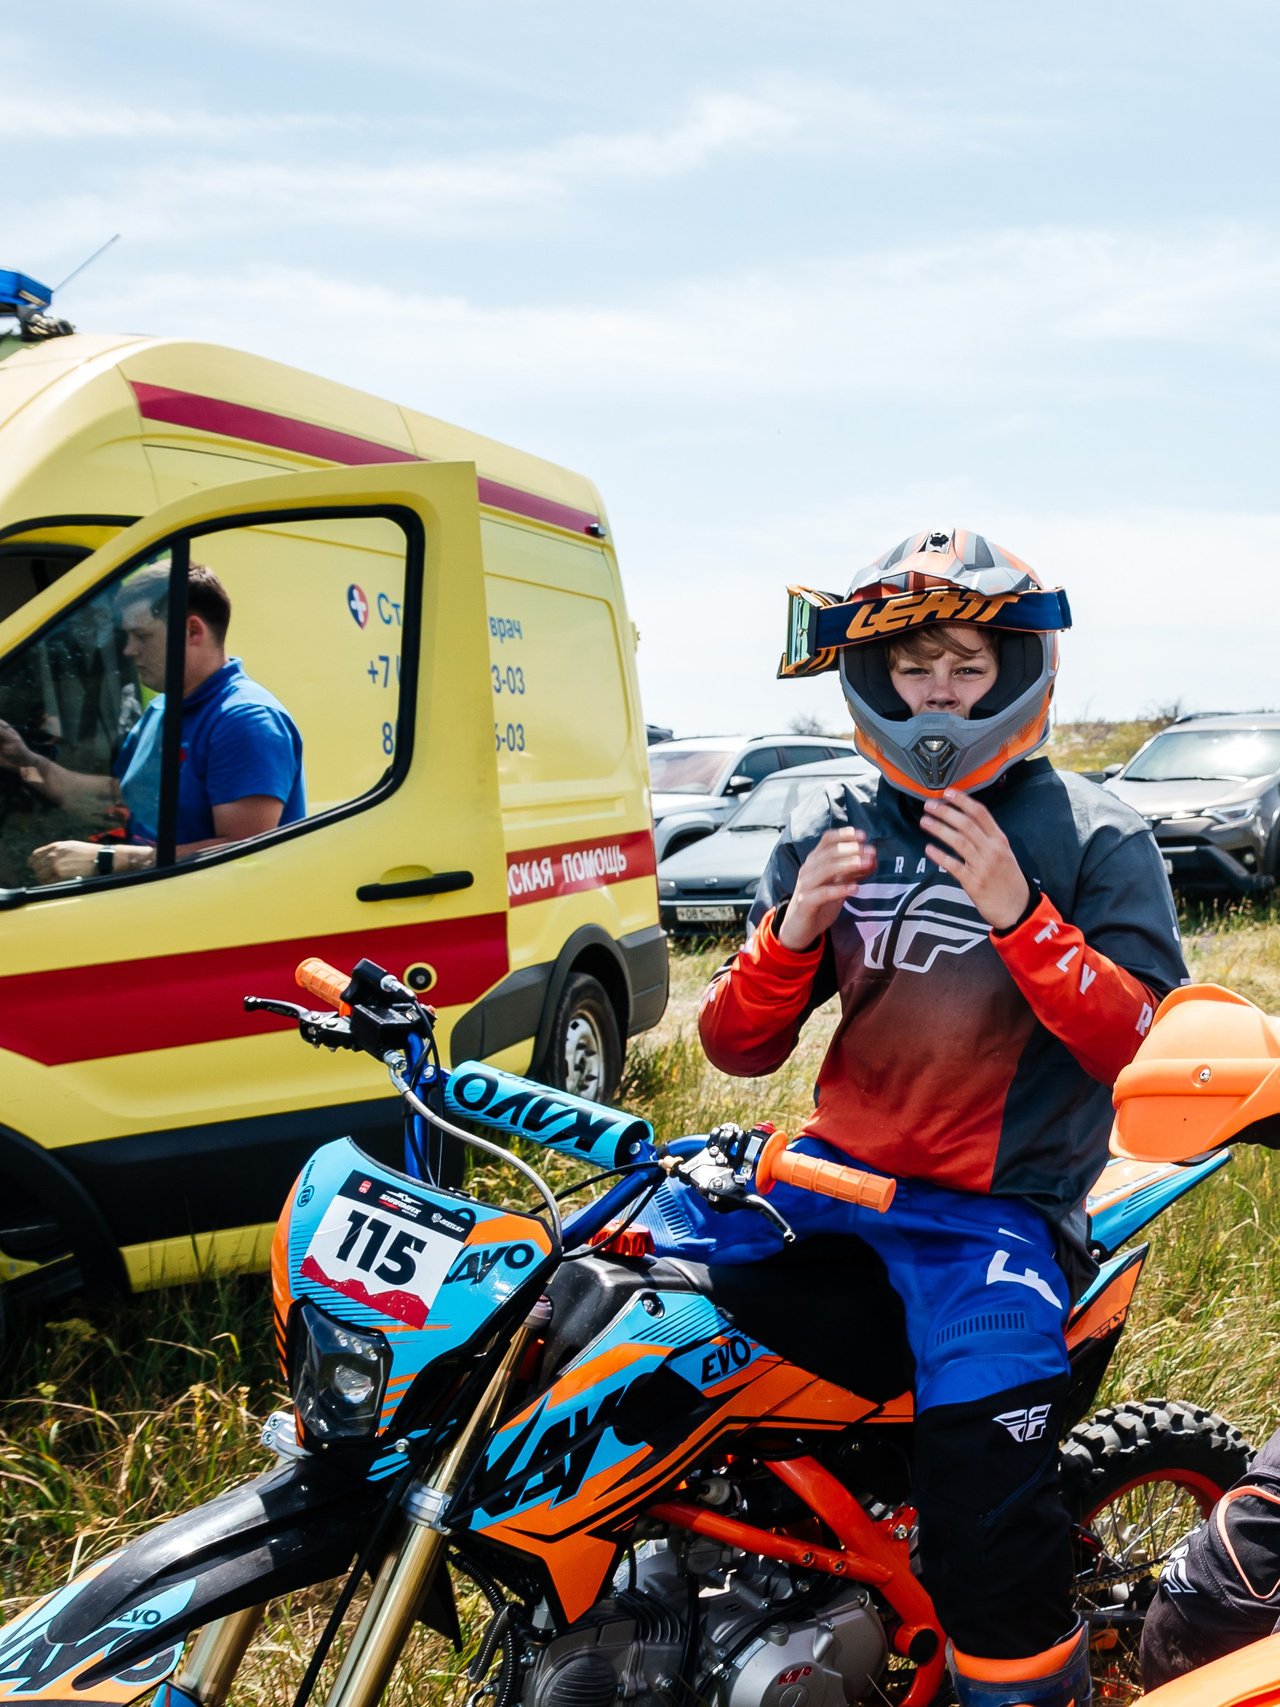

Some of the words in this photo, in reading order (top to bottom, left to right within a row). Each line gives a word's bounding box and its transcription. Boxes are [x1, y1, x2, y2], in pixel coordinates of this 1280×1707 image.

[488, 616, 522, 643] врач
[846, 590, 1021, 639] LEATT
[367, 655, 390, 688] +7
[491, 665, 525, 694] 3-03
[561, 845, 627, 884] ПОМОЩЬ
[1034, 920, 1097, 995] FLY
[453, 1073, 622, 1153] KAYO
[336, 1209, 428, 1286] 115
[701, 1335, 752, 1385] EVO
[118, 1609, 161, 1625] EVO
